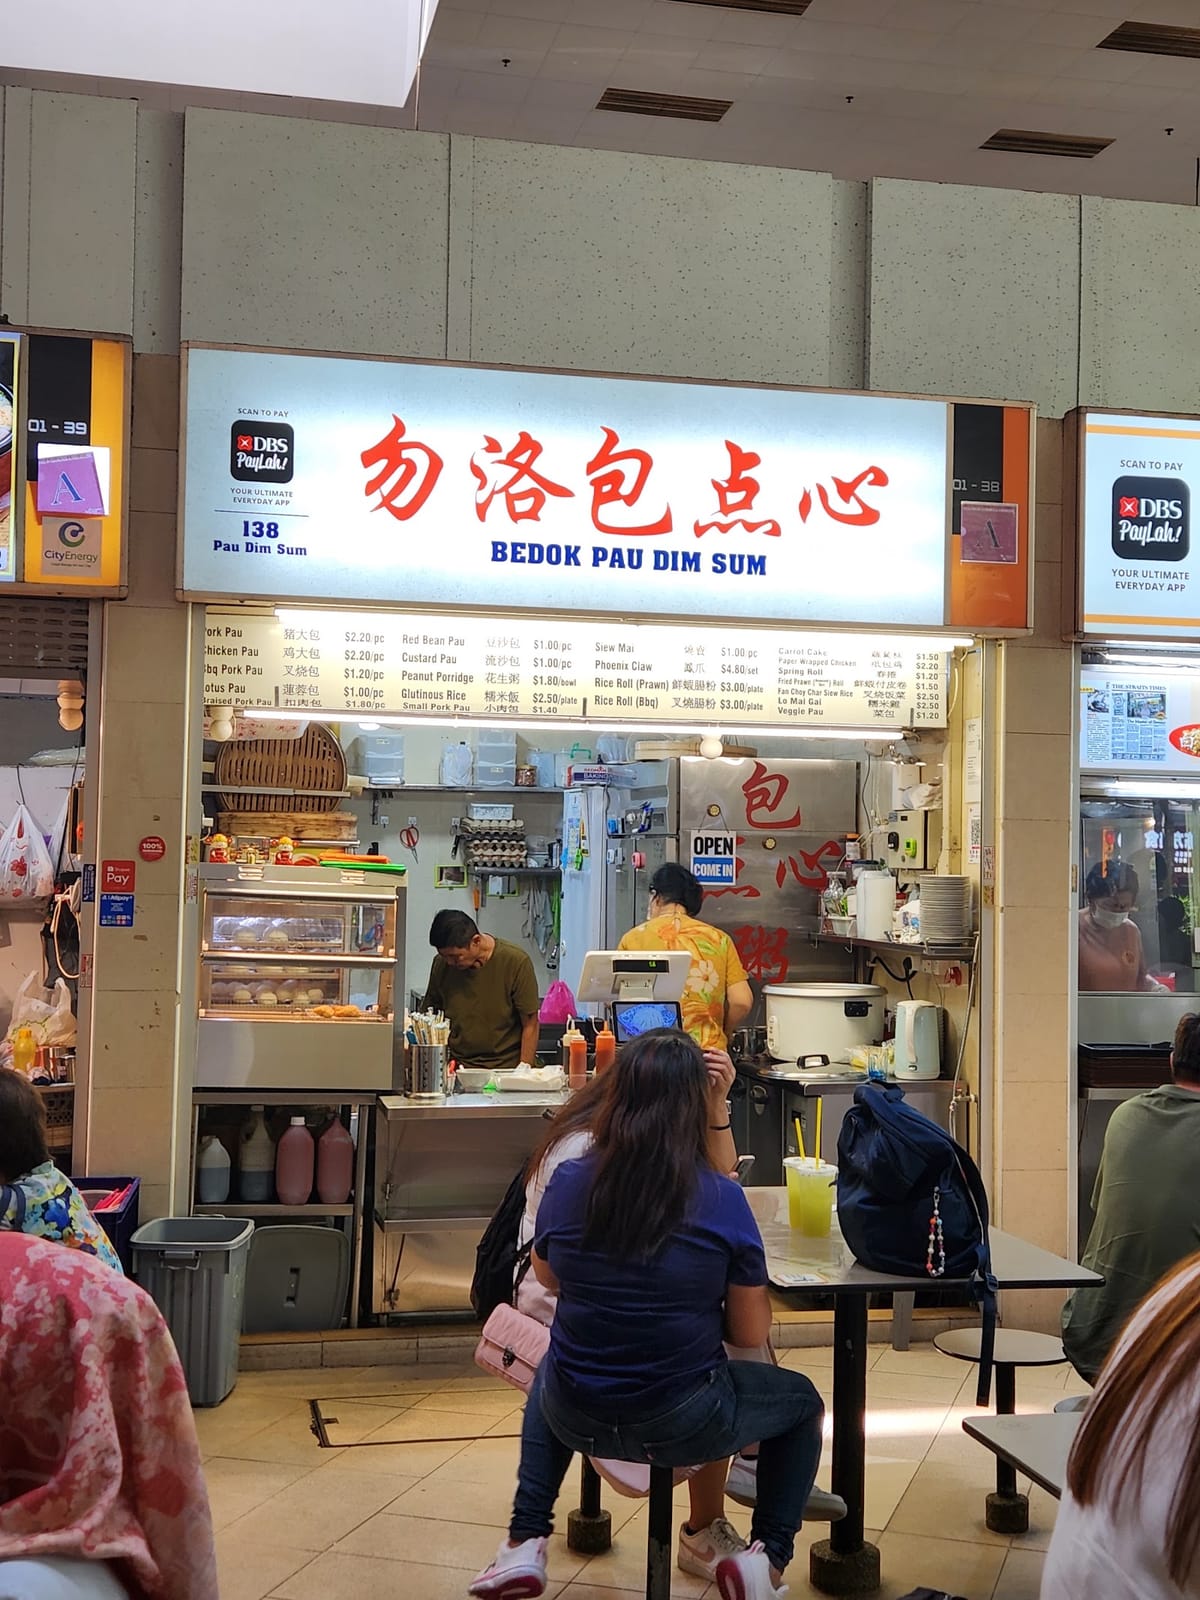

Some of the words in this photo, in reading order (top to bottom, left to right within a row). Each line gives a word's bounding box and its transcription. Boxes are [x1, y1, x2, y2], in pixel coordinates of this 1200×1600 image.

[237, 407, 259, 417] SCAN
[260, 409, 271, 417] TO
[273, 410, 289, 418] PAY
[28, 419, 47, 432] 01
[63, 421, 87, 435] 39
[253, 436, 288, 453] DBS
[237, 451, 287, 472] PayLah!
[1120, 459, 1146, 469] SCAN
[1148, 461, 1161, 470] TO
[1164, 462, 1183, 471] PAY
[360, 413, 889, 538] 勿洛包点心
[50, 471, 85, 505] A
[953, 479, 967, 490] 01
[981, 481, 1000, 492] 38
[231, 487, 253, 497] YOUR
[255, 488, 293, 498] ULTIMATE
[233, 496, 271, 505] EVERYDAY
[272, 498, 290, 506] APP
[1140, 499, 1182, 519] DBS
[243, 520, 279, 539] 138
[1118, 519, 1182, 546] PayLah!
[213, 540, 240, 553] Pau
[245, 541, 272, 554] Dim
[277, 543, 307, 556] Sum
[44, 550, 98, 563] CityEnergy
[491, 541, 581, 567] BEDOK
[592, 546, 643, 569] PAU
[653, 550, 701, 572] DIM
[712, 553, 766, 576] SUM
[1112, 568, 1139, 578] YOUR
[1142, 570, 1190, 580] ULTIMATE
[1115, 581, 1165, 591] EVERYDAY
[1167, 582, 1186, 592] APP
[204, 627, 222, 637] ork
[225, 627, 242, 637] Pau
[284, 628, 320, 641] 猪大包
[402, 634, 419, 644] Red
[423, 635, 445, 646] Bean
[448, 636, 465, 646] Pau
[242, 646, 259, 657] Pau
[595, 641, 615, 652] Siew
[618, 643, 634, 653] Mai
[778, 647, 804, 655] Carrot
[807, 648, 827, 656] Cake
[344, 650, 384, 663] $2.20/pc
[402, 652, 437, 663] Custard
[440, 653, 457, 664] Pau
[222, 664, 242, 675] Pork
[246, 665, 263, 675] Pau
[533, 657, 572, 670] $1.00/pc
[595, 660, 629, 670] Phoenix
[631, 661, 653, 671] Claw
[916, 662, 939, 670] $2.20
[344, 668, 384, 682] $1.20/pc
[402, 670, 433, 681] Peanut
[436, 671, 474, 684] Porridge
[778, 667, 804, 676] Spring
[204, 683, 225, 693] otus
[228, 683, 246, 693] Pau
[595, 677, 614, 688] Rice
[616, 678, 633, 688] Roll
[636, 679, 669, 692] (Prawn)
[720, 682, 764, 694] $3.00/plate
[343, 686, 384, 700] $1.00/pc
[401, 688, 444, 700] Glutinous
[447, 690, 466, 701] Rice
[257, 698, 272, 706] Pau
[403, 702, 428, 710] Small
[453, 703, 470, 712] Pau
[594, 695, 614, 706] Rice
[616, 696, 633, 706] Roll
[635, 696, 659, 709] (Bbq)
[720, 699, 763, 712] $3.00/plate
[778, 697, 788, 705] Lo
[790, 697, 806, 705] Mai
[778, 707, 806, 716] Veggie
[741, 760, 801, 829] 包
[694, 837, 733, 856] OPEN
[694, 864, 722, 876] COME
[722, 864, 733, 877] IN
[106, 873, 129, 885] Pay
